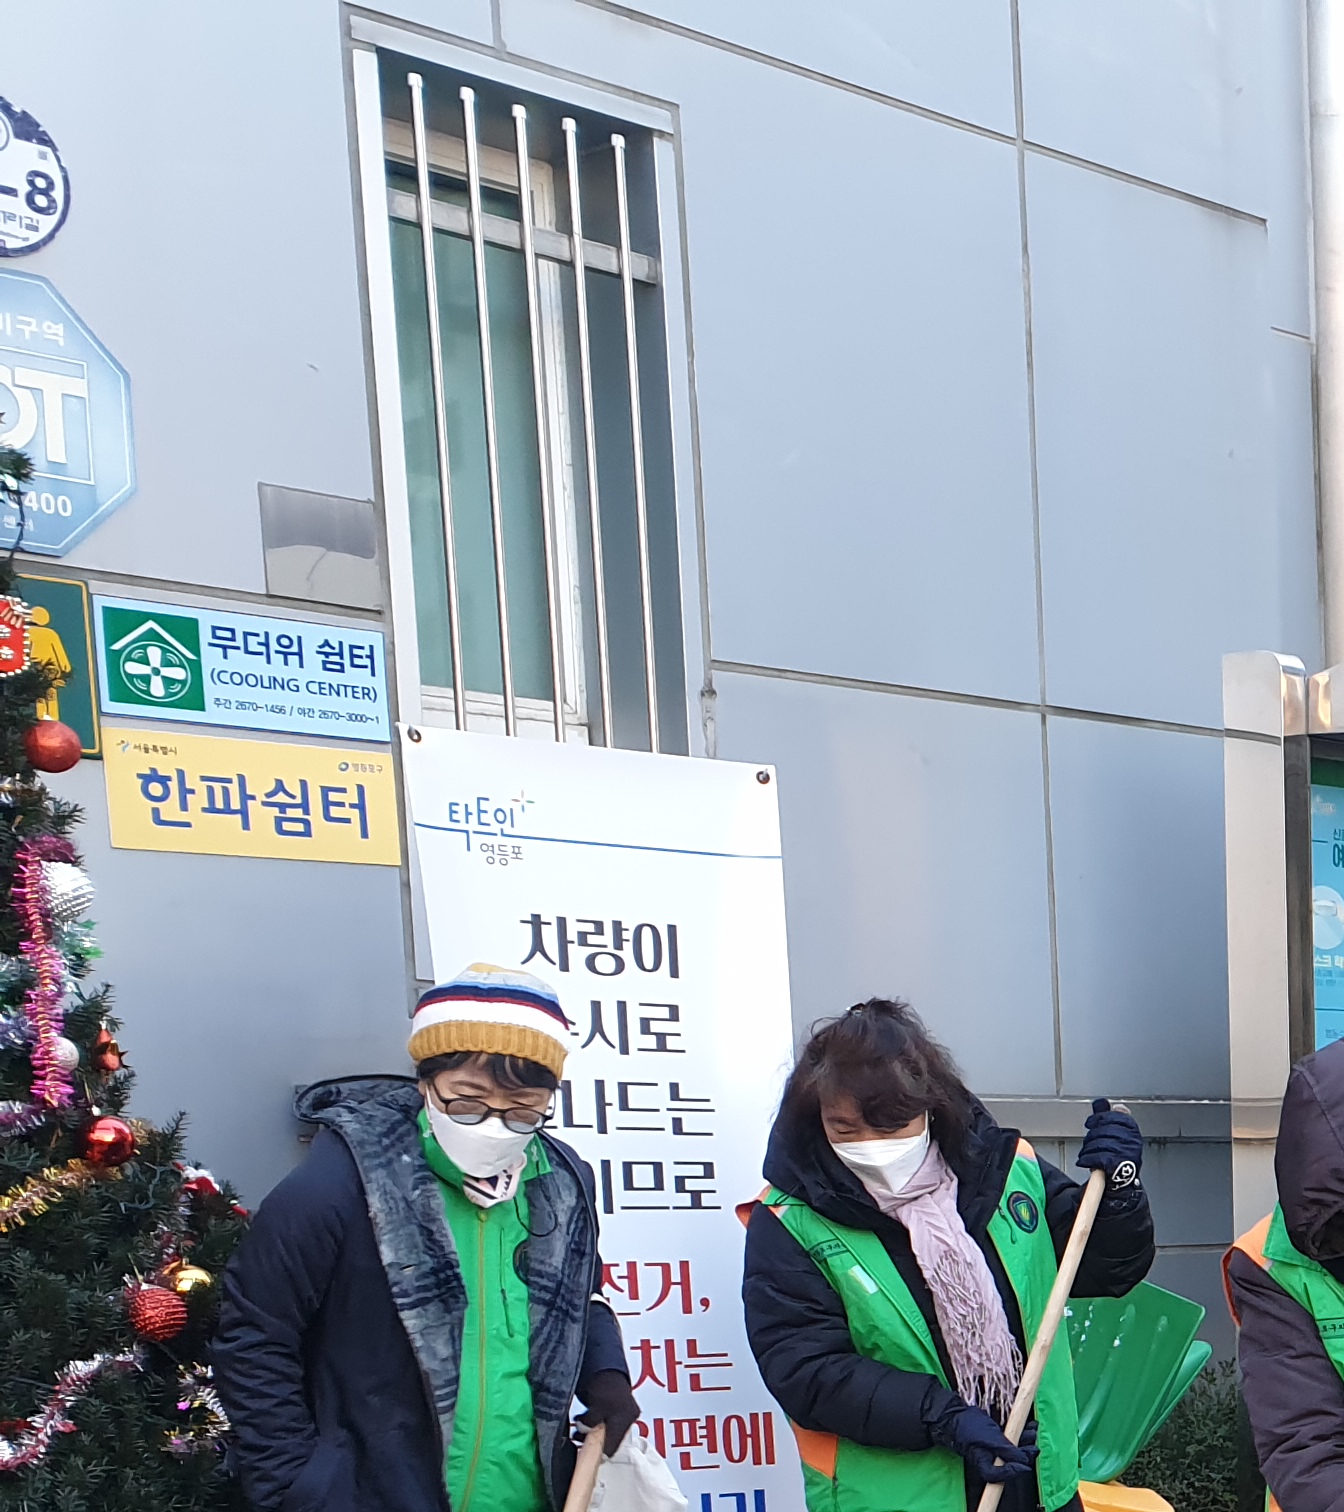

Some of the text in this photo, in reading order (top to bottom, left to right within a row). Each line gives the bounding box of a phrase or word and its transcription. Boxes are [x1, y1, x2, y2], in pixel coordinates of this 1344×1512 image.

[207, 625, 376, 678] 무더위 쉼터
[210, 667, 378, 703] (COOLING CENTER)
[136, 767, 370, 840] 한파쉼터
[480, 842, 525, 867] 영등포
[520, 913, 681, 979] 차량이
[568, 1000, 686, 1056] 시로
[602, 1260, 711, 1316] 전거,
